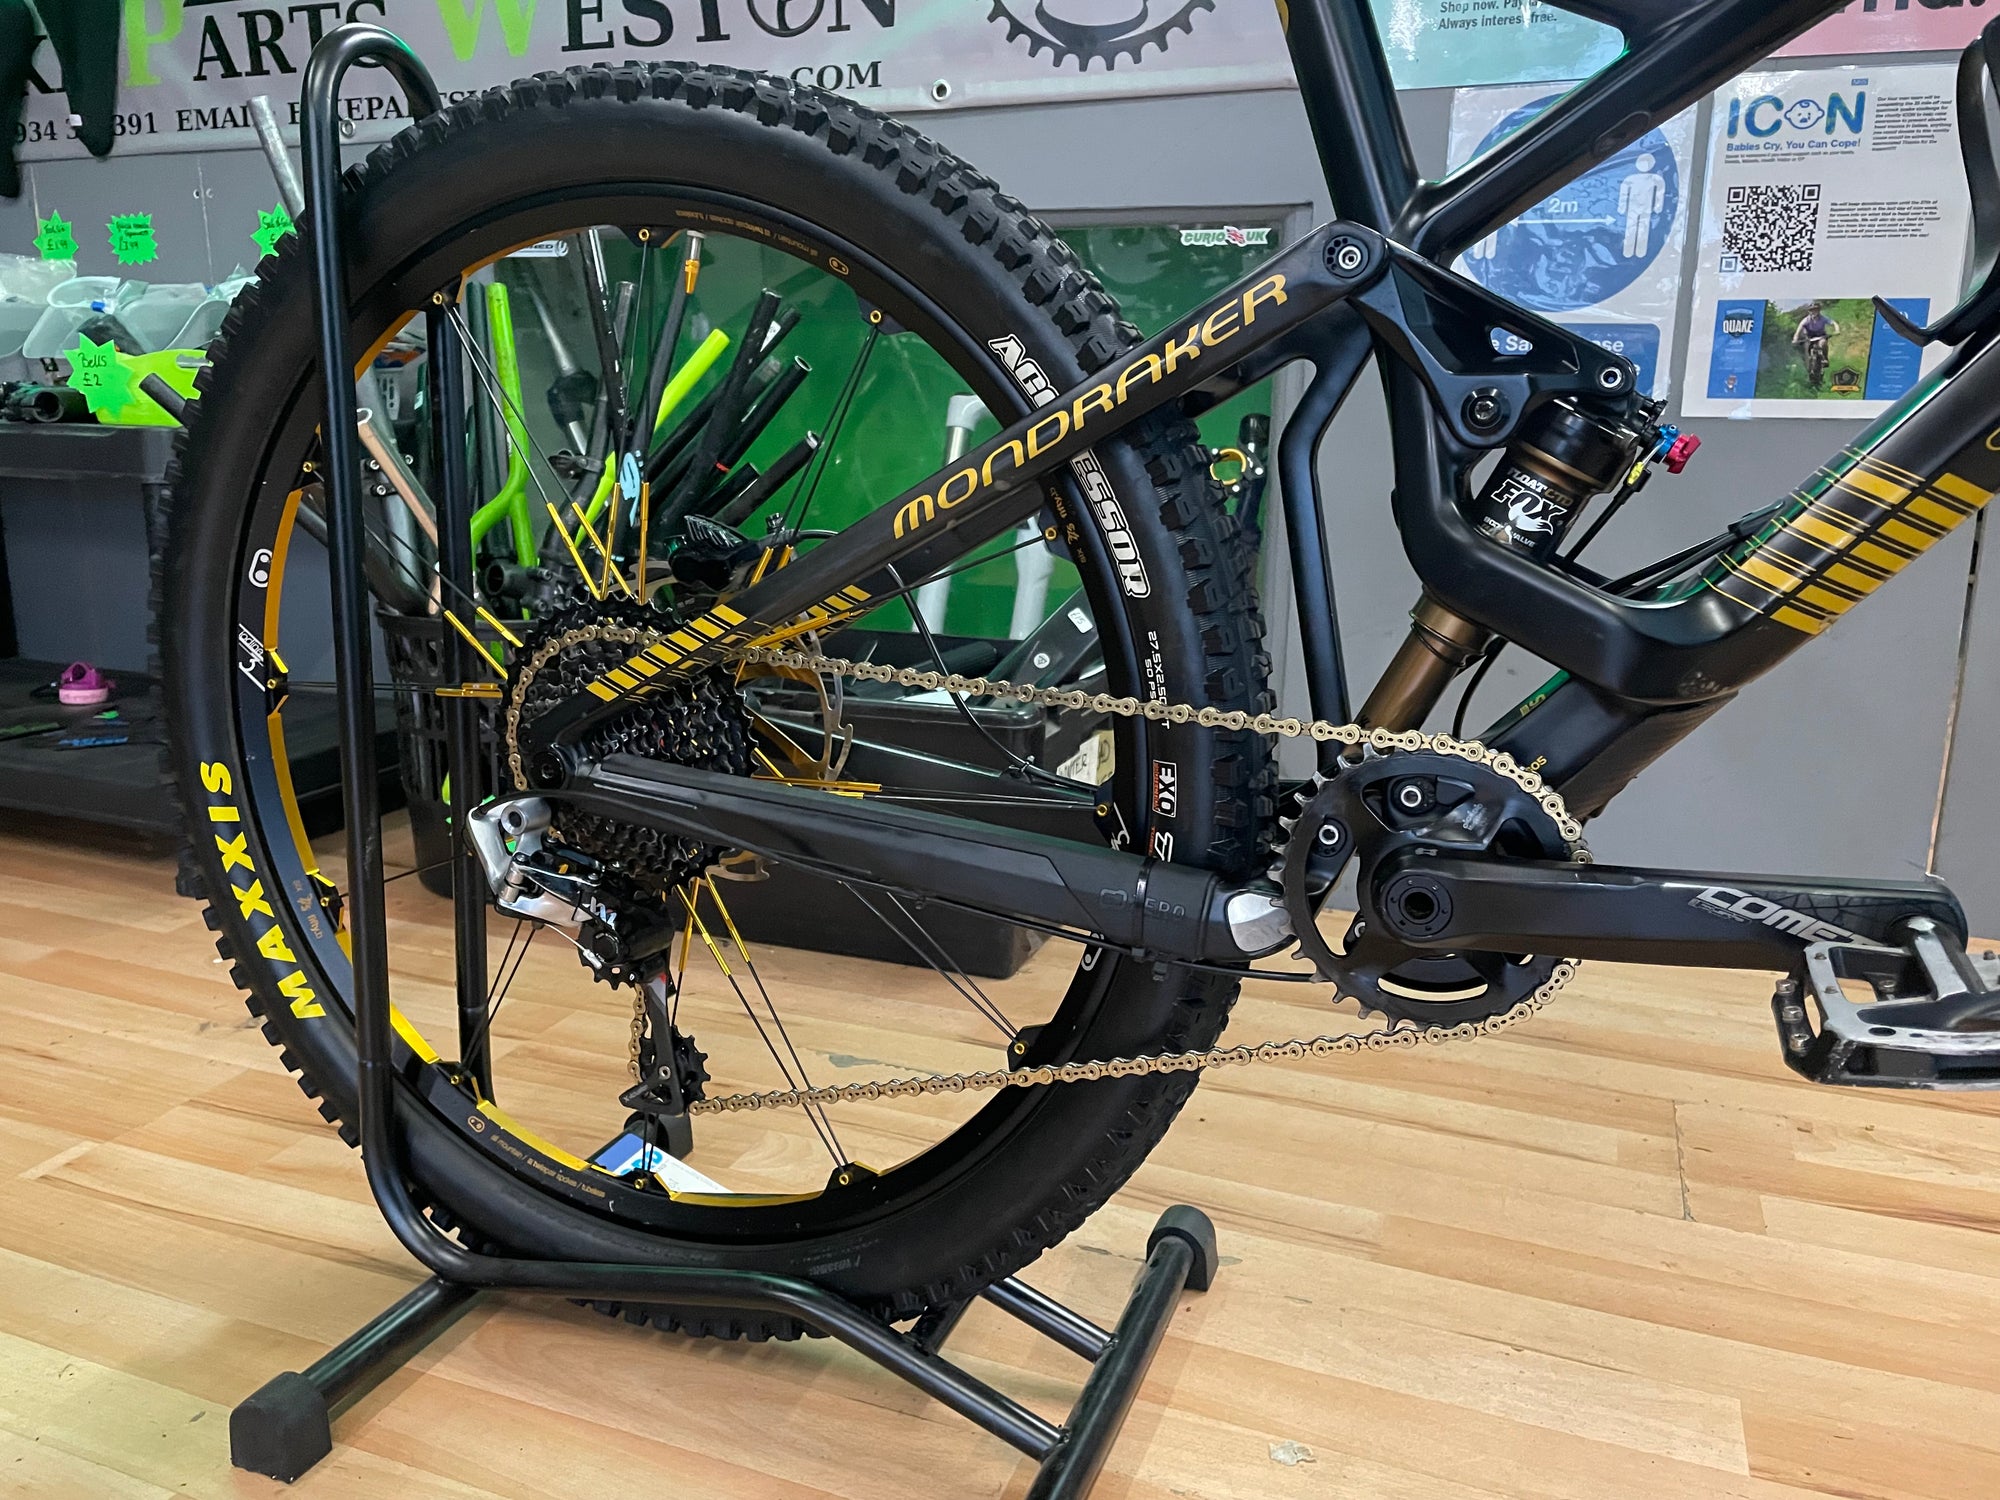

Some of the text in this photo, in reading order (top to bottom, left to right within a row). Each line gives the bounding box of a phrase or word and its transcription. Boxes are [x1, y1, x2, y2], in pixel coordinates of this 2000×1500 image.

[1440, 0, 1469, 14] Shop
[1473, 2, 1500, 12] now.
[1438, 11, 1557, 31] Always interes free.
[176, 105, 253, 132] EMAI
[1726, 138, 1861, 151] Babies Cry, You Can Cope!
[1547, 196, 1578, 213] 2m
[1722, 319, 1755, 333] QUAKE
[78, 352, 107, 368] Bells
[893, 274, 1288, 539] MONDRAKER
[1507, 467, 1548, 492] FLOAT
[1490, 478, 1568, 525] FOX
[1158, 764, 1176, 817] EXO
[199, 760, 326, 1020] MAXXIS
